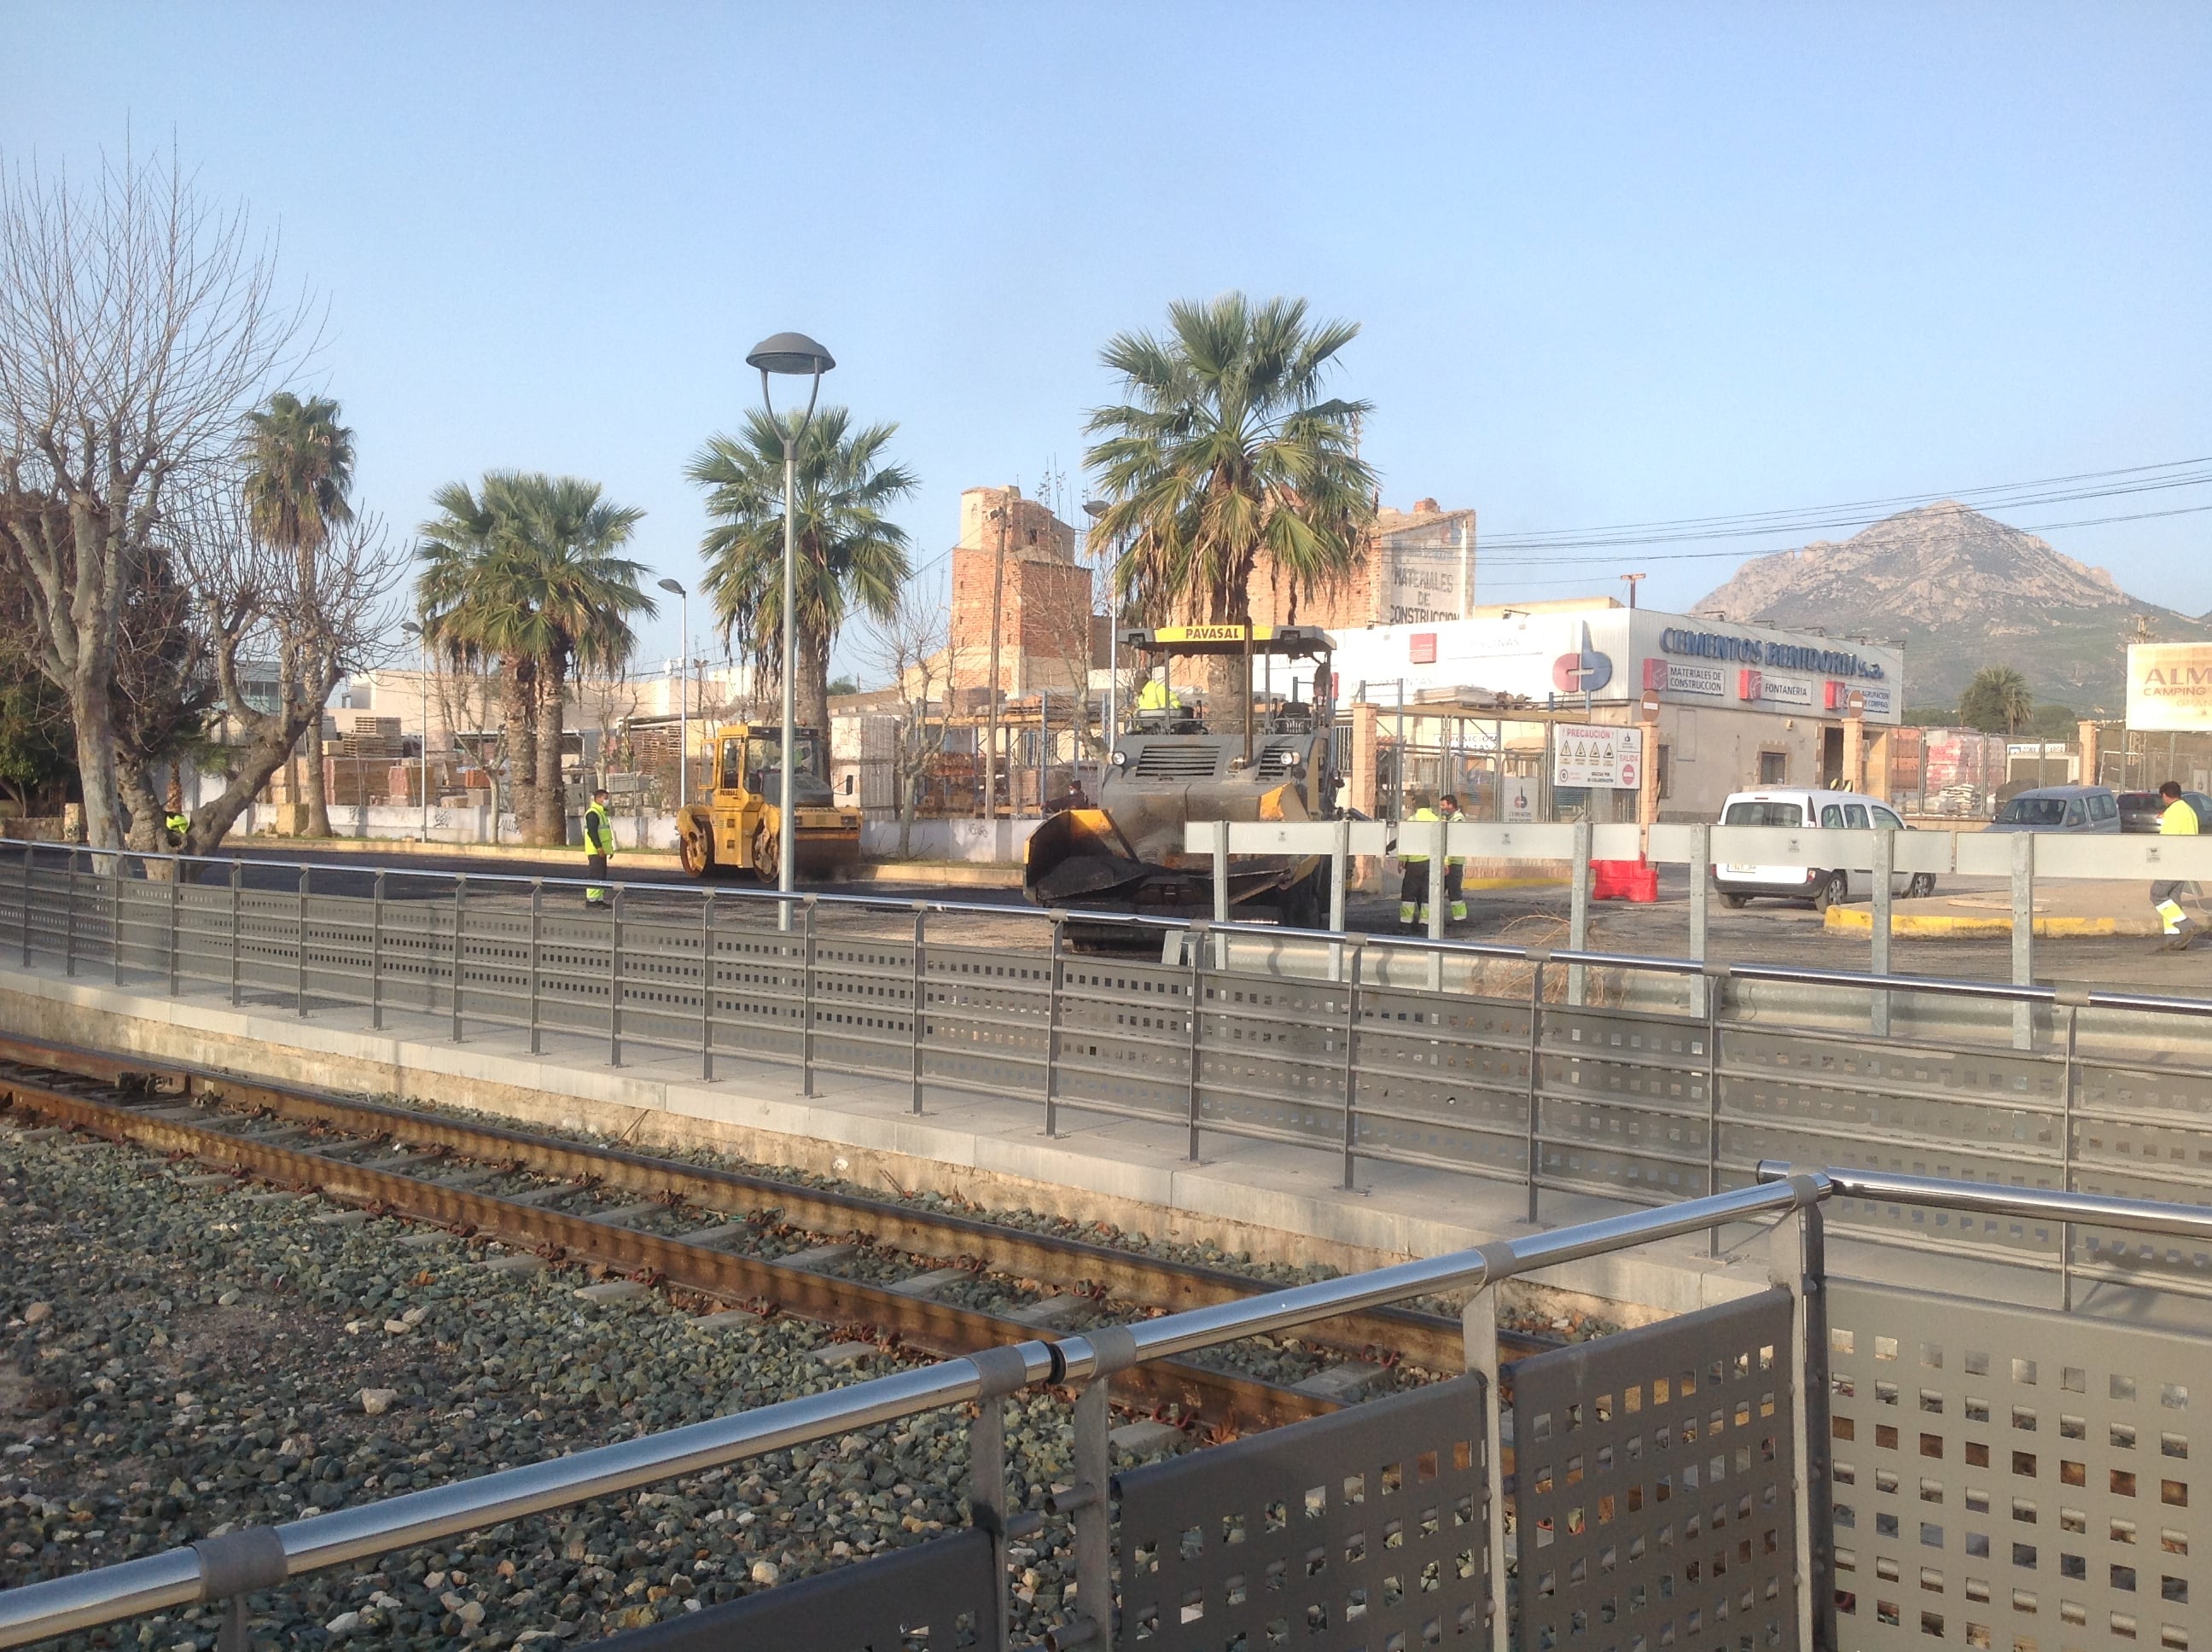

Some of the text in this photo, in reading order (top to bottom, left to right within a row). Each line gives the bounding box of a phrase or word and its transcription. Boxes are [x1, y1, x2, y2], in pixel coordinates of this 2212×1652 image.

[1394, 567, 1454, 593] MATERIALES
[1417, 590, 1430, 607] DE
[1185, 627, 1239, 640] PAVASAL
[1659, 627, 1762, 665] CEMENTOS
[1765, 641, 1858, 677] BENIDORM
[1670, 667, 1721, 681] MATERIALES DE
[1670, 678, 1721, 692] CONSTRUCCION
[2144, 687, 2206, 695] CAMPING
[1567, 728, 1611, 739] PRECAUCIÓN
